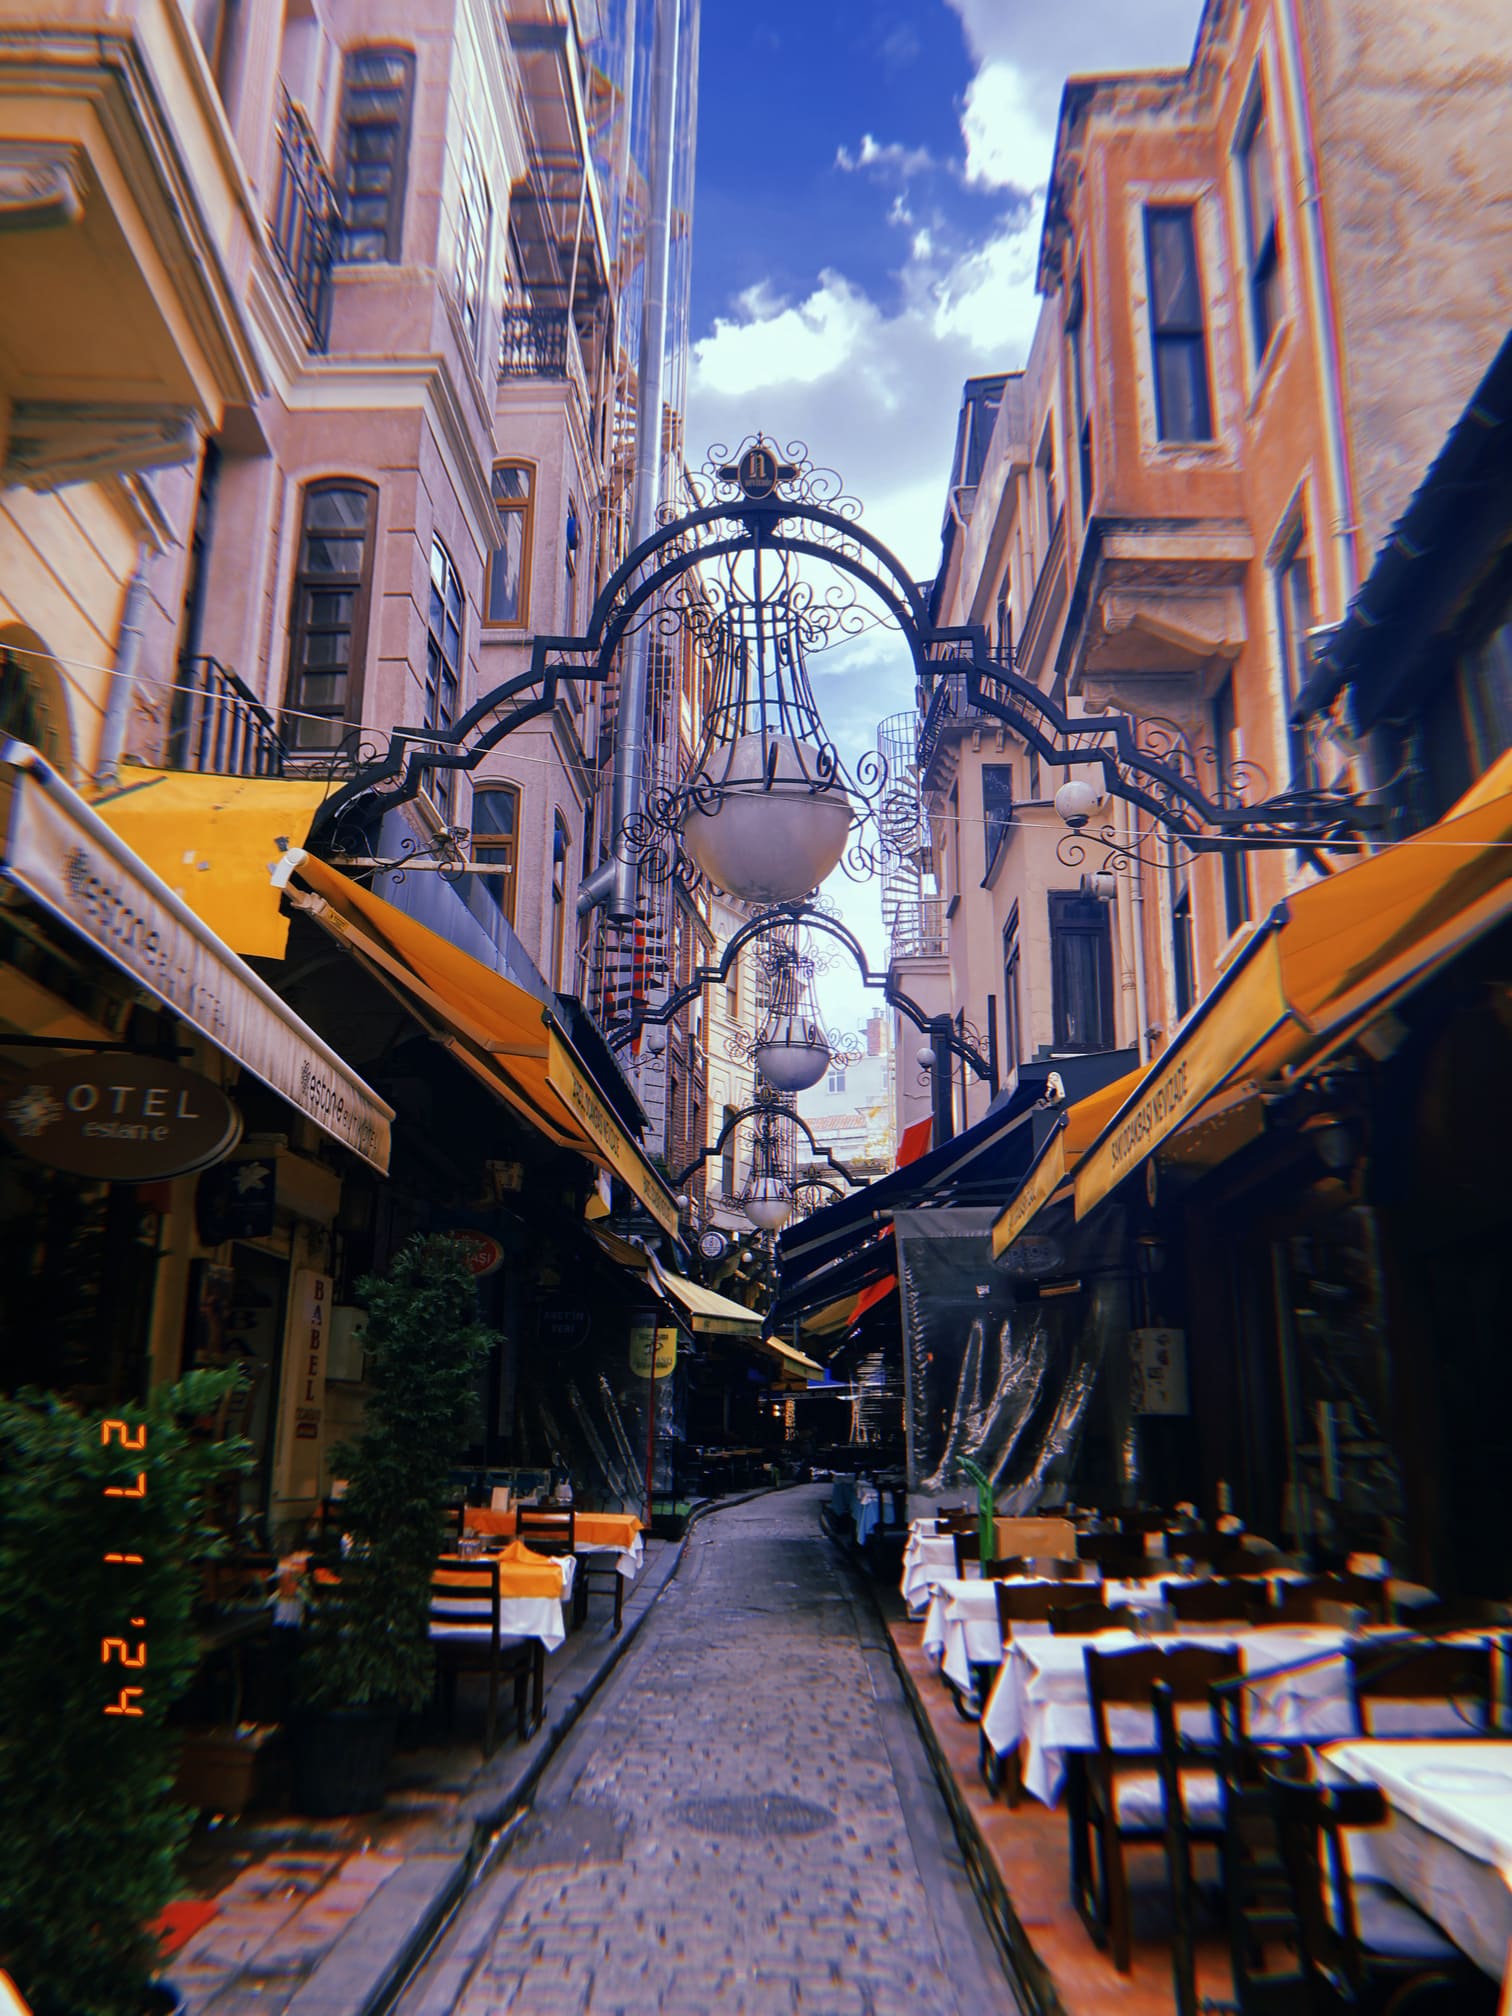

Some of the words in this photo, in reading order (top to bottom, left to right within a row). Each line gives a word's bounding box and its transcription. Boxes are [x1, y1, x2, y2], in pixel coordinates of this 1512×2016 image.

[66, 1083, 200, 1119] OTEL
[81, 1118, 171, 1142] estane
[304, 1279, 324, 1401] BABEL
